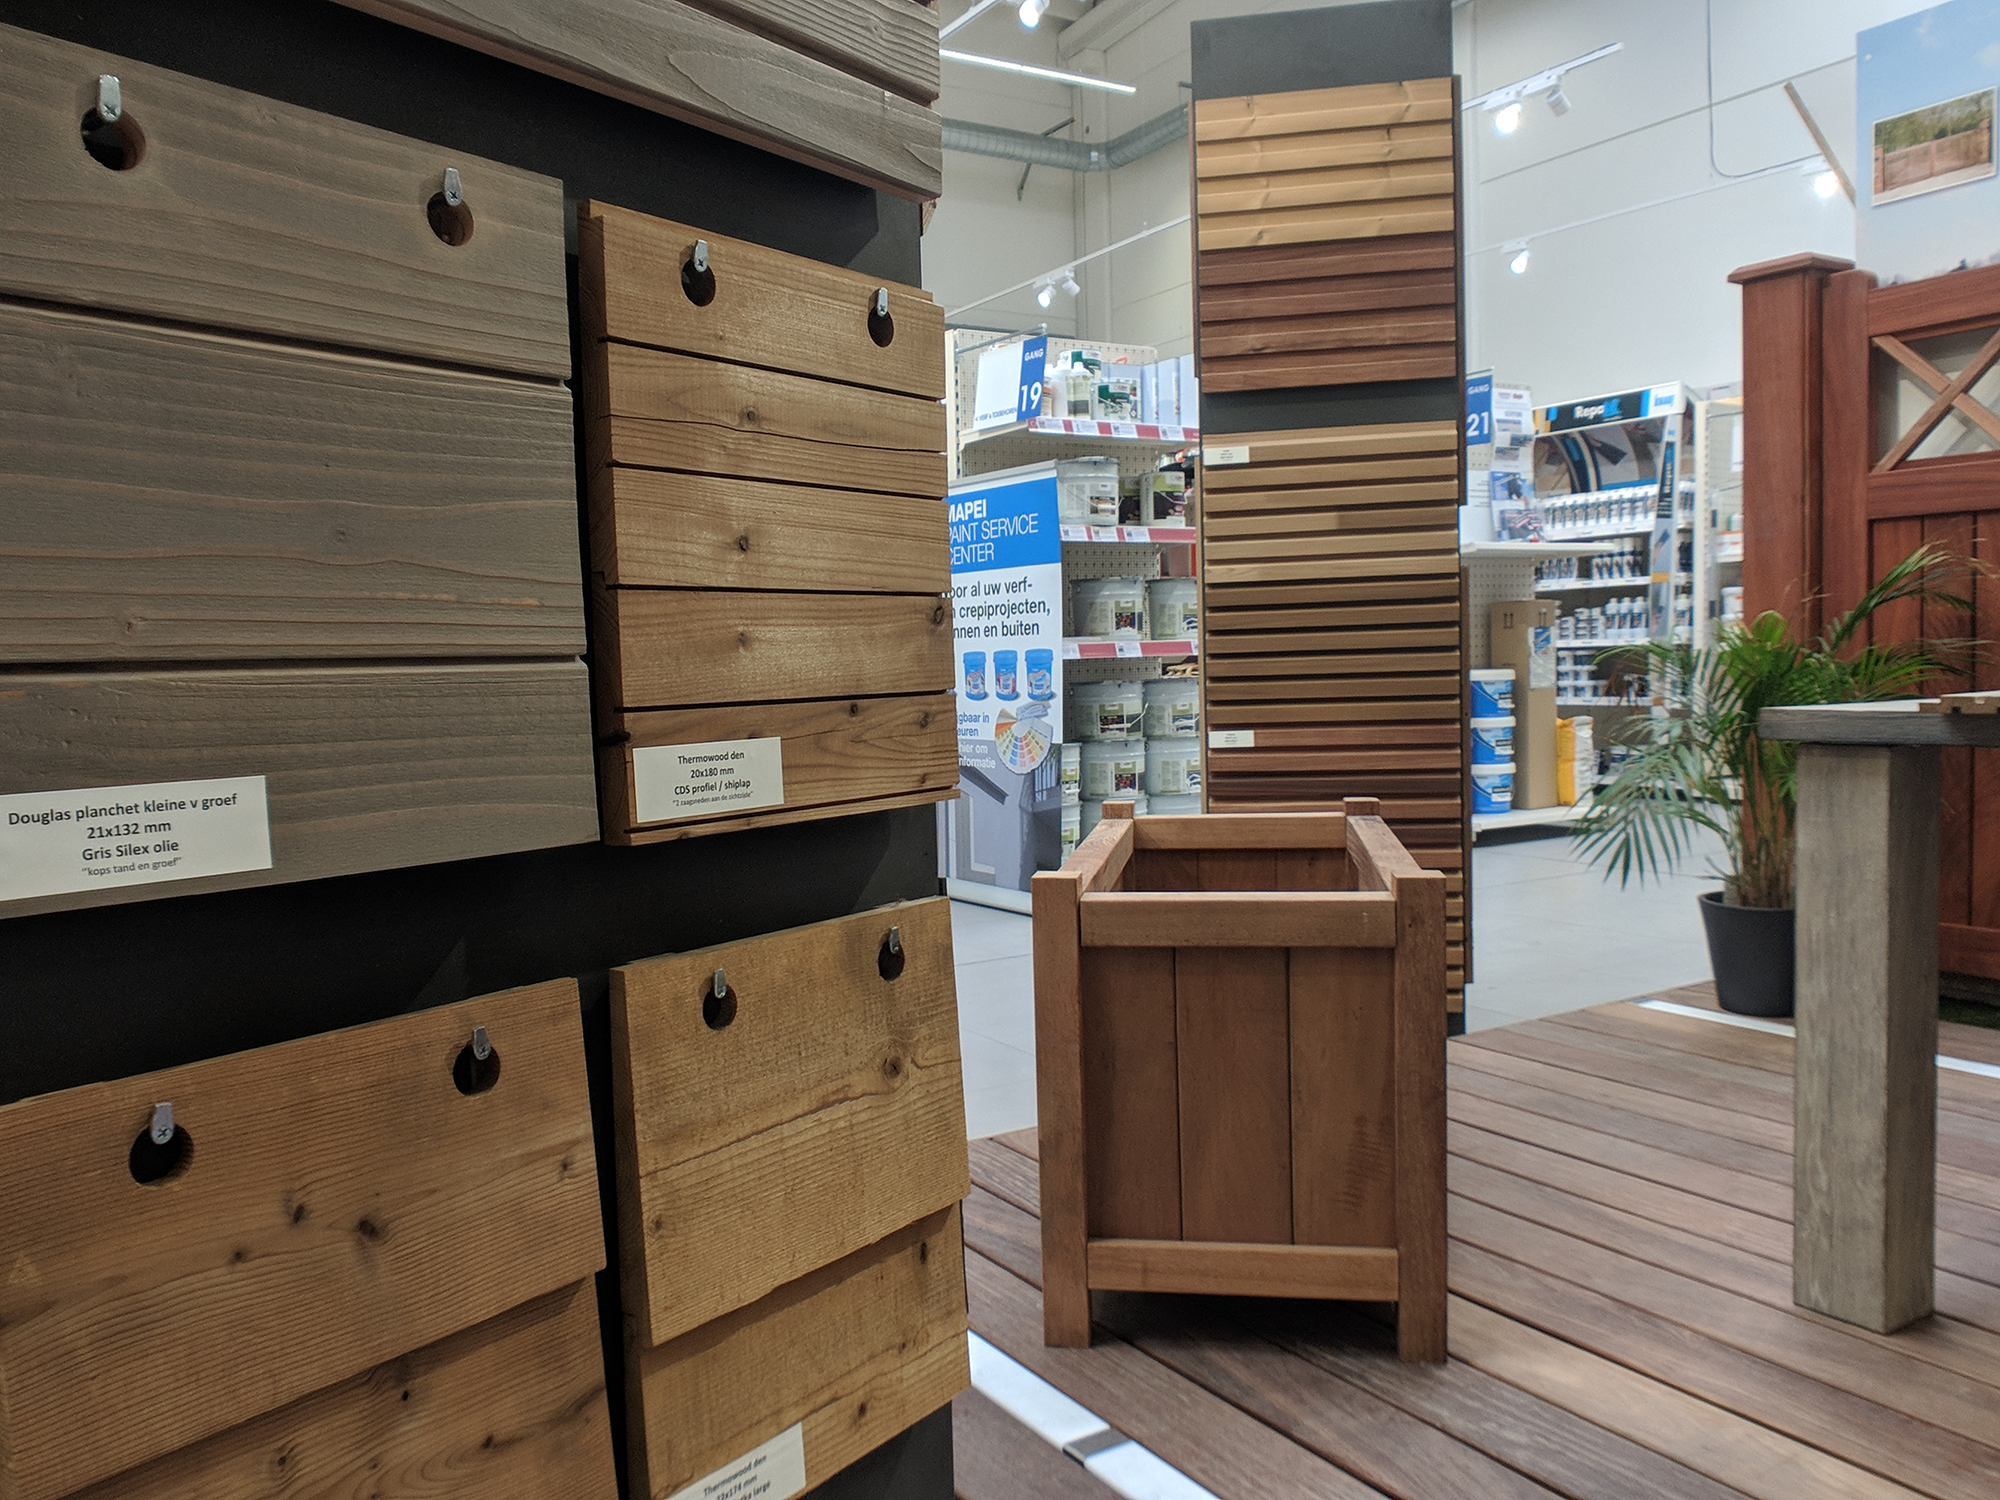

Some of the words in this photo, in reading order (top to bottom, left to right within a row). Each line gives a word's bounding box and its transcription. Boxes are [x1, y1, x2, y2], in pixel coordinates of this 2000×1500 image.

[1024, 348, 1044, 361] GANG
[1021, 381, 1042, 412] 19
[1467, 384, 1490, 395] GANG
[1466, 411, 1490, 437] 21
[981, 512, 1039, 540] SERVICE
[971, 580, 980, 597] al
[984, 583, 1001, 596] uw
[1004, 576, 1032, 594] verf-
[959, 599, 1050, 621] crepiprojecten,
[953, 625, 980, 639] nnen
[983, 624, 998, 637] en
[1001, 620, 1039, 637] buiten
[957, 712, 981, 724] gbaar
[983, 712, 990, 723] in
[957, 727, 979, 737] euren
[677, 751, 729, 764] Thermowood
[730, 750, 745, 760] den
[975, 744, 989, 754] om
[959, 756, 996, 769] nformatie
[690, 767, 719, 779] 20x180
[720, 766, 735, 776] mm
[674, 784, 690, 795] CDS
[692, 782, 717, 795] profiel
[724, 778, 751, 791] shiplap
[8, 808, 71, 826] Douglas
[76, 802, 140, 822] planchet
[144, 799, 186, 814] kleine
[189, 799, 198, 809] v
[201, 793, 238, 811] groef
[86, 823, 140, 840] 21x132
[144, 821, 172, 834] mm
[82, 847, 112, 861] Gris
[115, 844, 150, 859] Silex
[153, 840, 179, 853] olie
[113, 863, 136, 873] tand
[138, 862, 150, 871] en
[704, 1461, 752, 1498] Thermowood
[754, 1454, 767, 1467] den
[753, 1480, 771, 1496] large
